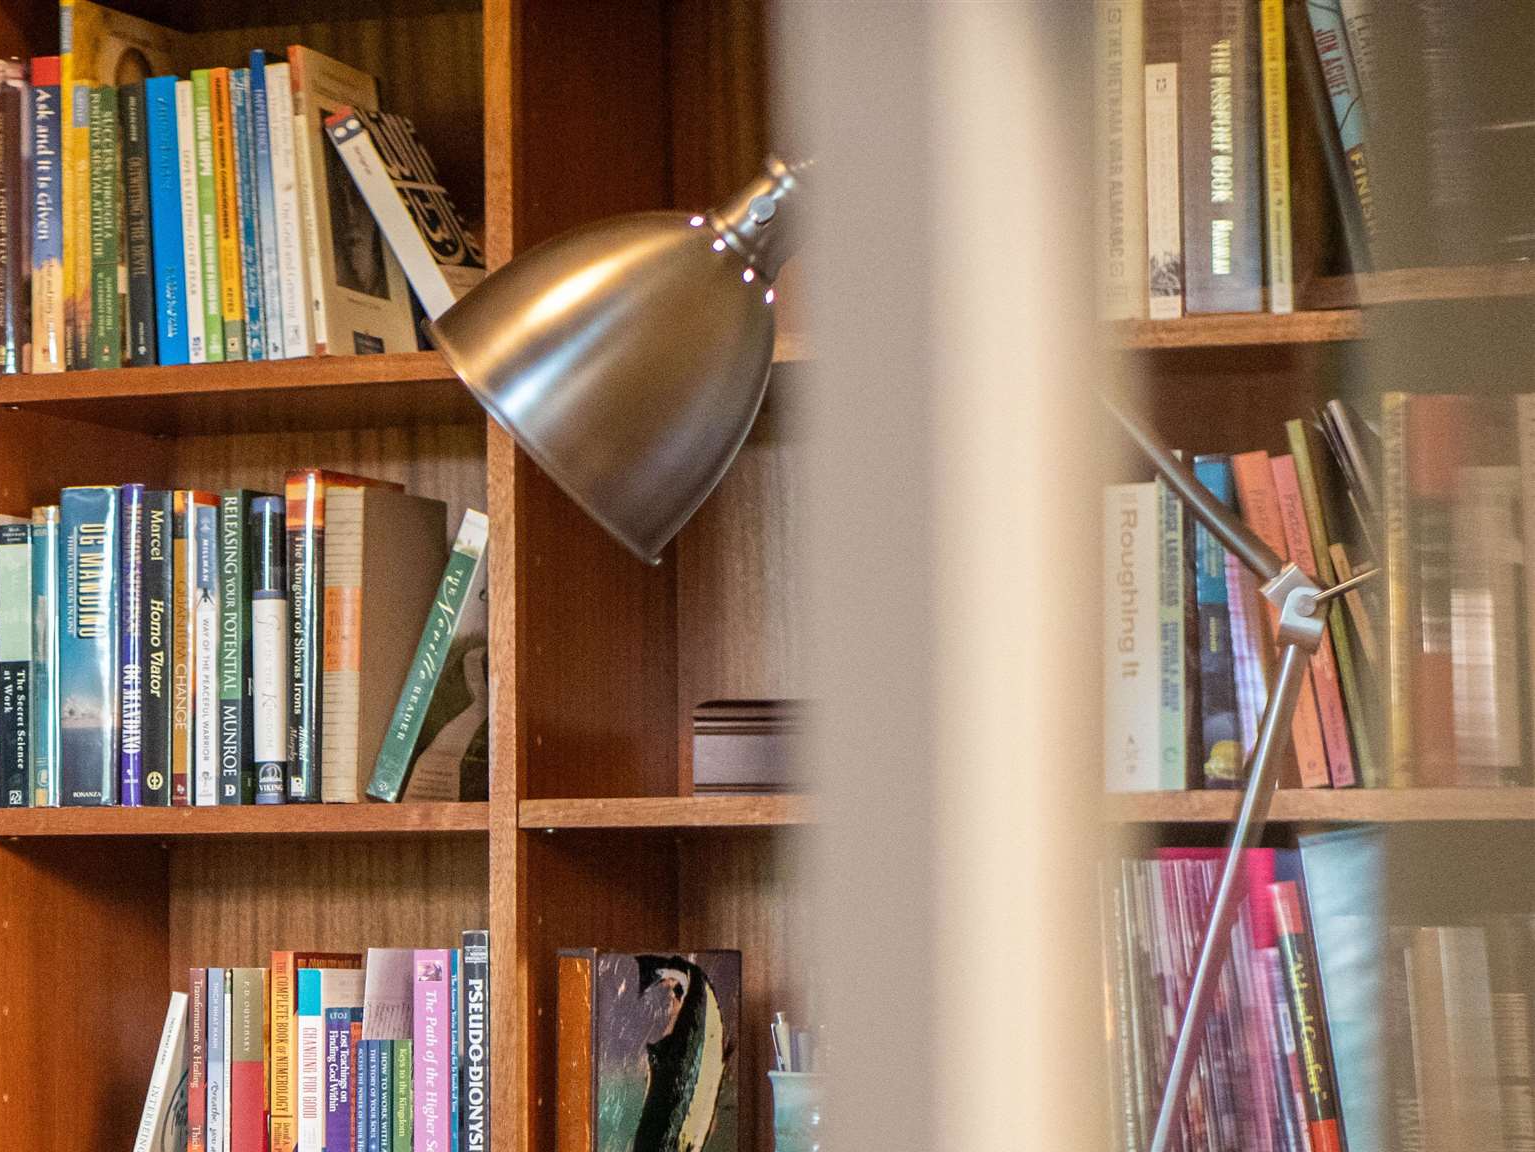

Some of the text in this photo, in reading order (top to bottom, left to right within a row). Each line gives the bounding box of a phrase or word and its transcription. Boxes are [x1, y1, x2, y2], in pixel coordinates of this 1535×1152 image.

[102, 111, 114, 171] SUCCESS
[1211, 39, 1233, 204] THE PASSPORT BOOK
[36, 89, 54, 240] Ask and It Is Given
[91, 93, 104, 259] POSITIVE MENTAL ATTITUDE
[67, 536, 75, 634] THREE VOLUMES IN ONE
[78, 523, 107, 640] OG MANDINO
[201, 538, 209, 583] MILLMAN
[1117, 507, 1139, 680] Roughing It
[150, 509, 164, 699] Marcel Homo Viator
[223, 495, 238, 777] RELEASING YOUR POTENTIAL MUNROE
[293, 536, 305, 715] The Kingdom of Shivas Irons
[175, 580, 187, 730] QUANTUM CHANGE
[201, 617, 210, 761] WAY OF THE PEACEFUL WARRIOR
[396, 575, 457, 742] Neville READER
[3, 670, 13, 714] at Work
[16, 669, 26, 770] The Secret Science
[122, 663, 142, 755] OG MANDINO
[259, 784, 283, 792] VIKING
[191, 978, 202, 1042] Transformation
[425, 990, 437, 1013] The
[425, 1015, 437, 1047] Path
[191, 1044, 202, 1053] &
[191, 1055, 202, 1089] Healing
[275, 975, 289, 1113] COMPLETE BOOK NUMEROLOGY
[303, 1027, 317, 1074] CHANGING
[328, 1030, 338, 1112] Finding God Within
[338, 1030, 349, 1103] Lost Teachings on
[425, 1048, 437, 1062] of
[425, 1064, 437, 1089] the
[303, 1076, 317, 1093] FOR
[303, 1094, 317, 1119] GOOD
[381, 1078, 388, 1090] TO
[397, 1048, 406, 1138] Keys to the Kingdom
[425, 1091, 437, 1136] Higher
[191, 1125, 202, 1152] Thich
